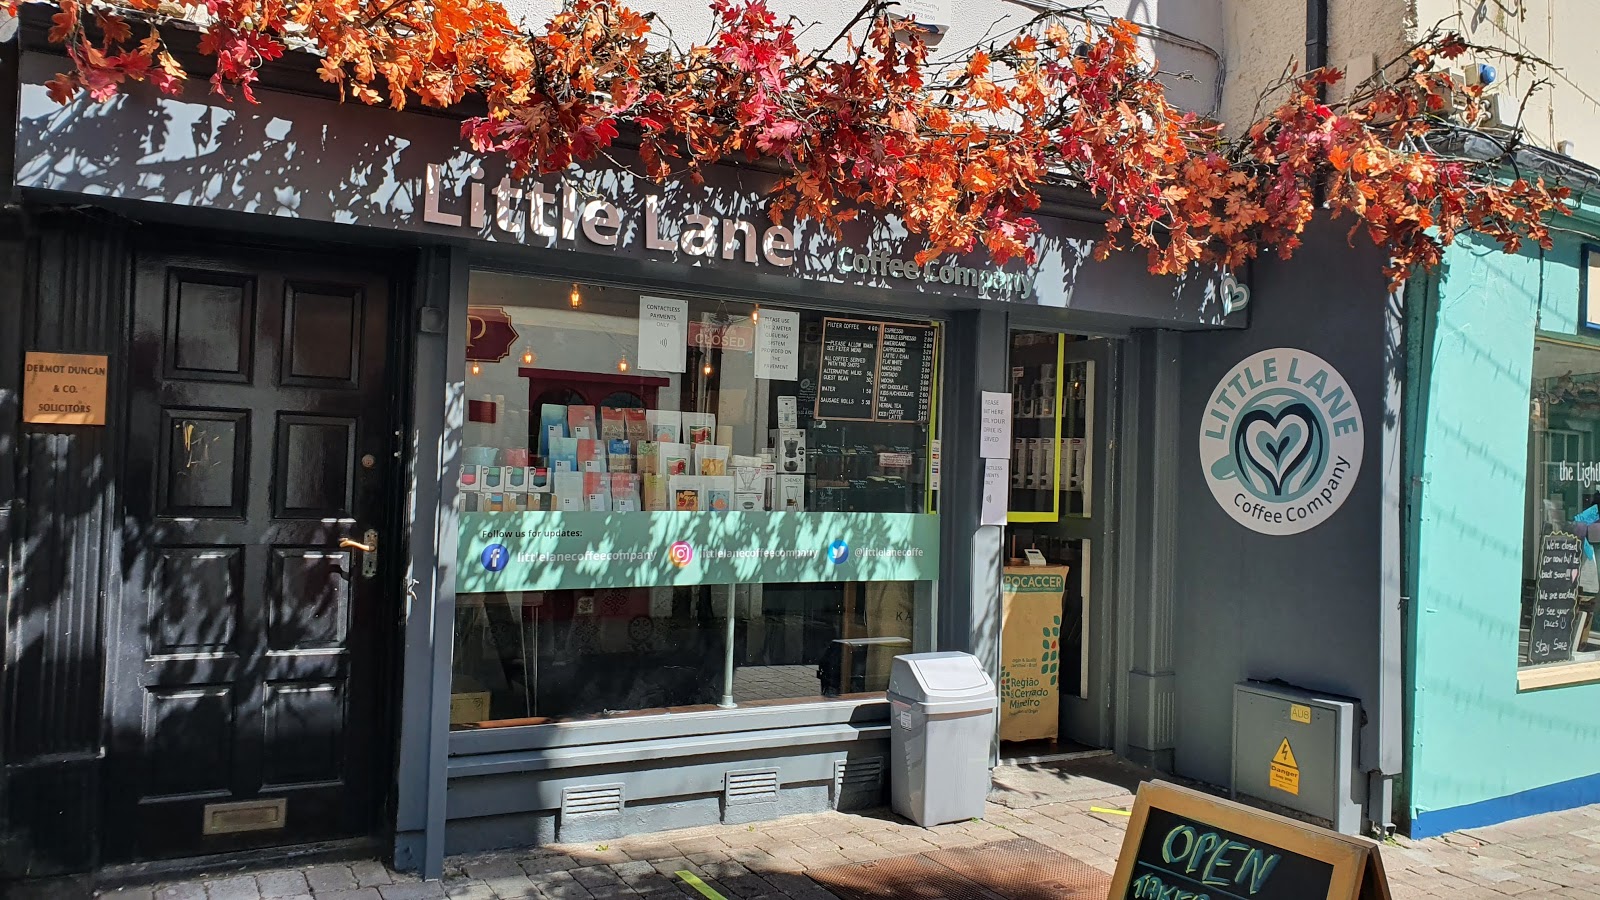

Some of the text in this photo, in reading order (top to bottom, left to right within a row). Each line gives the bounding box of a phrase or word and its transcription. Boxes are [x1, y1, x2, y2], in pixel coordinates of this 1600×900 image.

[423, 162, 795, 267] Little Lane
[836, 246, 1035, 300] Coffee Company
[646, 304, 681, 313] CONTACTLESS
[650, 313, 677, 321] PAYMENTS
[694, 333, 746, 348] CLOSED
[26, 363, 106, 376] DERMOT DUNCAN
[52, 384, 78, 394] & CO.
[1205, 357, 1359, 441] LITTLE LANE
[38, 403, 91, 413] SOLICITORS
[1559, 460, 1574, 481] the
[1234, 455, 1351, 524] Coffee Company
[482, 530, 513, 539] Follow
[528, 530, 542, 538] for
[544, 530, 583, 541] updates:
[854, 547, 924, 558] @littlelanecoffe
[1003, 576, 1062, 588] POCACCER
[1271, 765, 1298, 778] Danger
[1162, 825, 1282, 894] OPEN
[1133, 873, 1211, 900] TAK
